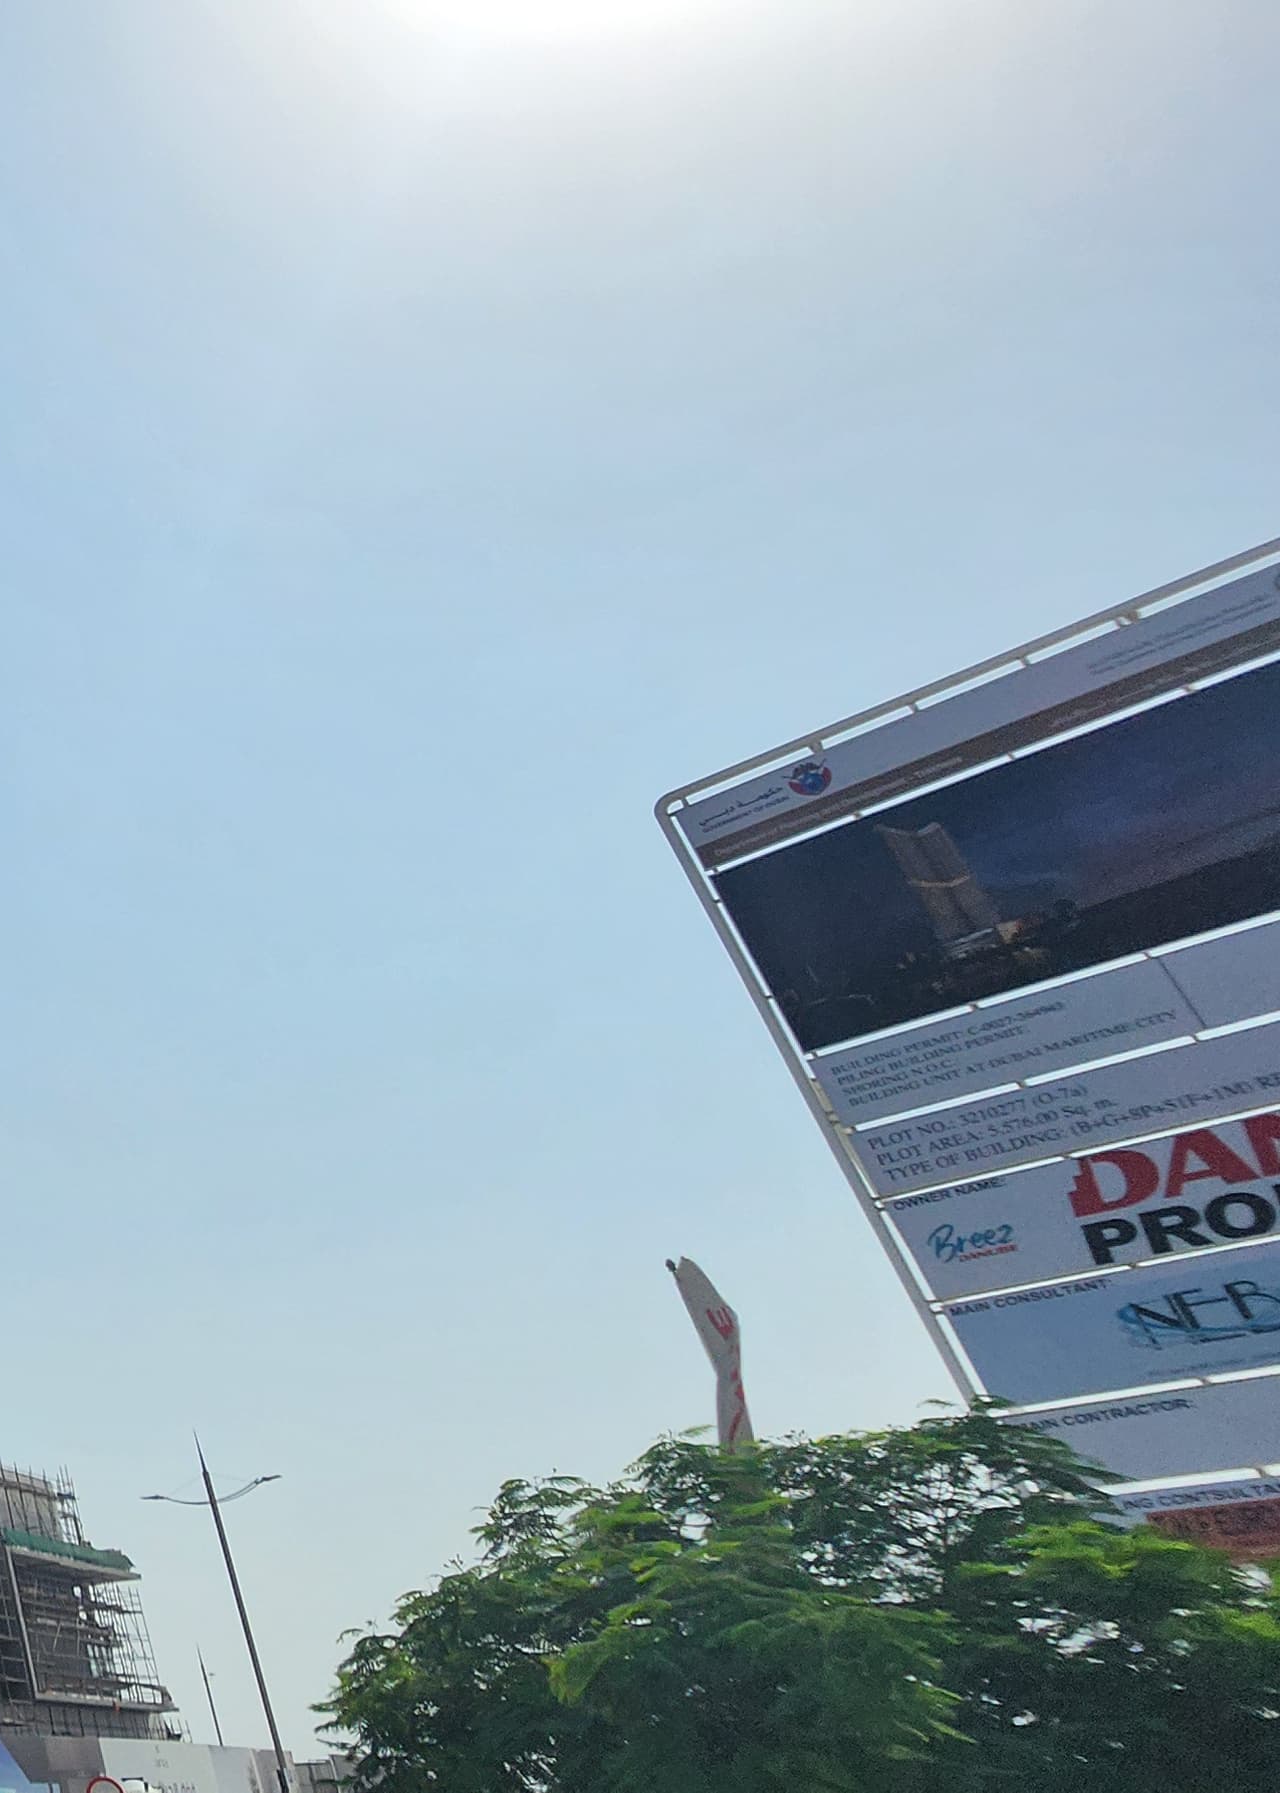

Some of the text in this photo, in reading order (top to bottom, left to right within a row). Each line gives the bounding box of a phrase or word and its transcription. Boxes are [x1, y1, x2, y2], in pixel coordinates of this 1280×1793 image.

[831, 1048, 902, 1076] BUILDING
[837, 1065, 886, 1086] PILING
[889, 1045, 961, 1071] BUILDING
[848, 1081, 921, 1107] BUILDING
[923, 1070, 961, 1087] UNIT
[965, 1062, 986, 1075] AT
[989, 1045, 1041, 1069] DUBAI
[1042, 1020, 1130, 1053] MARITIME
[841, 1071, 908, 1096] SHORING
[867, 1129, 916, 1150] PLOT
[876, 1144, 925, 1166] PLOT
[929, 1131, 985, 1153] AREA:
[883, 1161, 933, 1182] TYPE
[935, 1153, 961, 1169] OF
[964, 1127, 1067, 1161] BUILDING:
[893, 1177, 1007, 1211] OWNER NAME:
[1080, 1183, 1280, 1265] PRO
[927, 1224, 1015, 1263] Breez
[949, 1300, 991, 1316] MAIN
